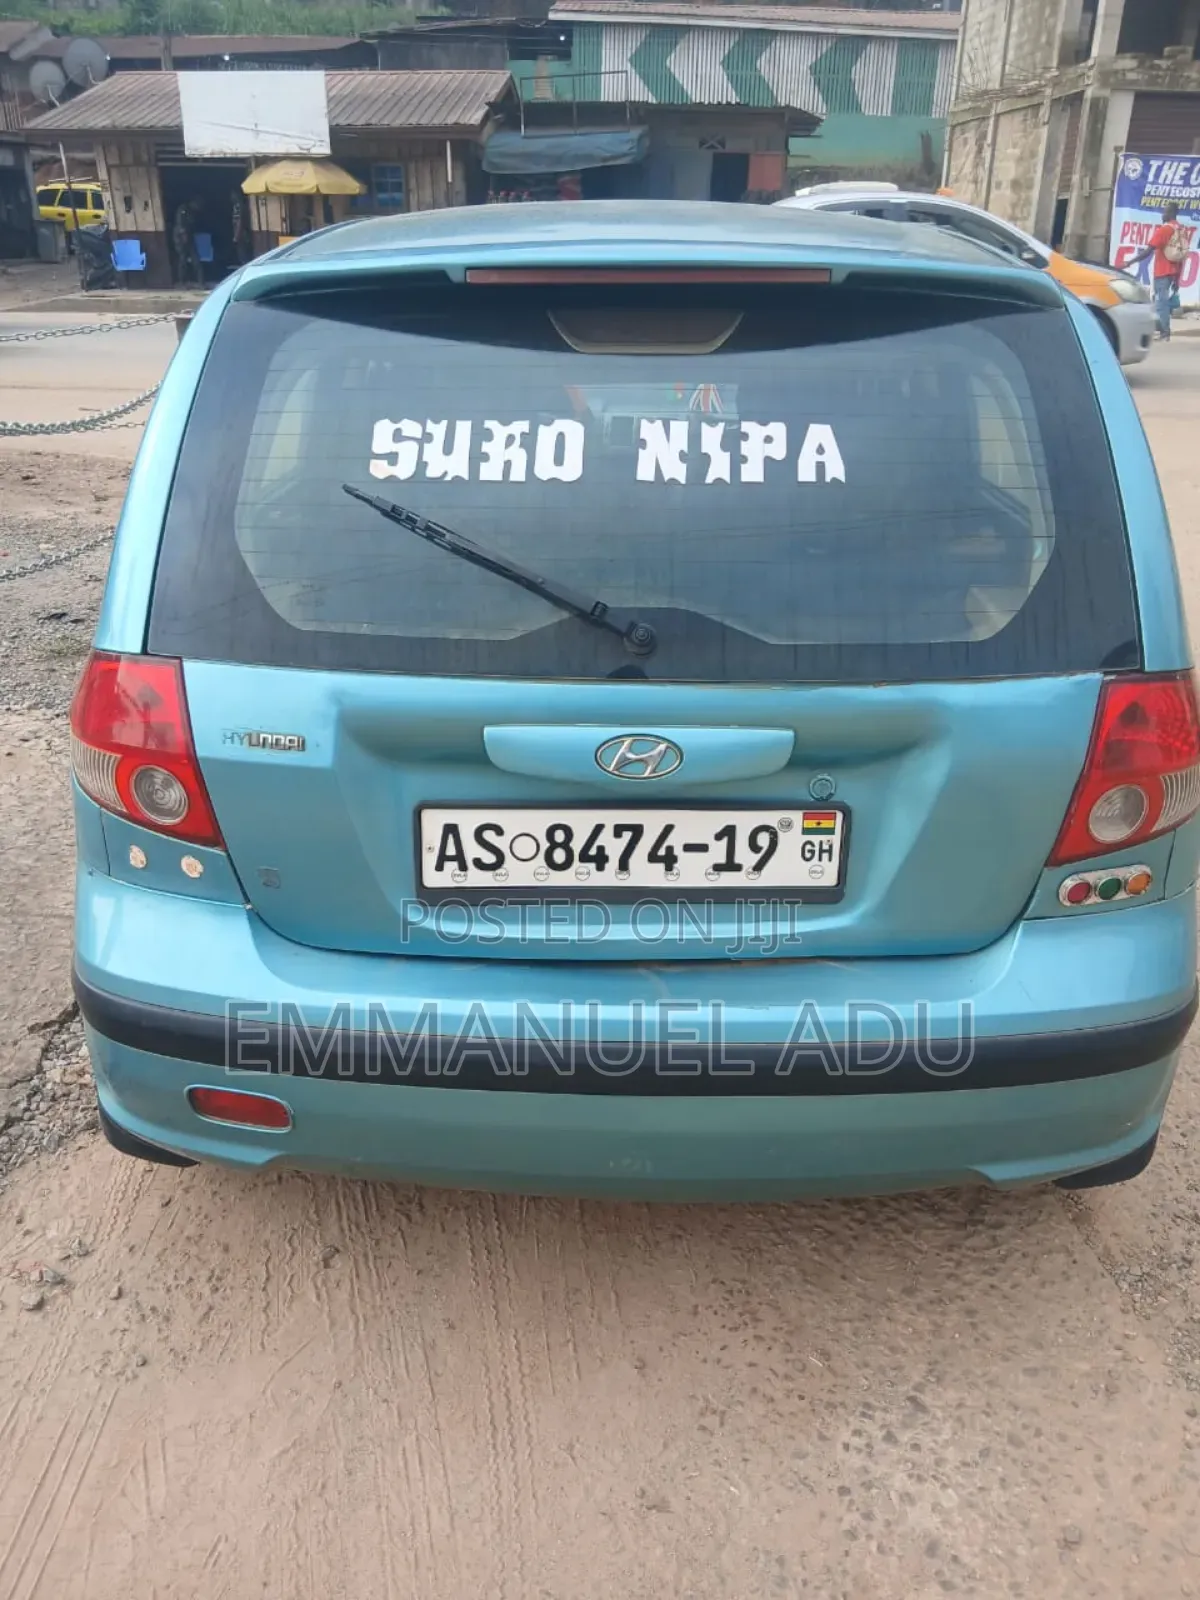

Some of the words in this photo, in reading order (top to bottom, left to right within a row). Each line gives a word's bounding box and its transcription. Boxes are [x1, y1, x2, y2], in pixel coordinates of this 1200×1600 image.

[1148, 160, 1191, 185] THE
[636, 419, 846, 484] NIPA
[434, 823, 506, 872] AS
[544, 823, 779, 873] 8474-19
[801, 840, 833, 862] GH
